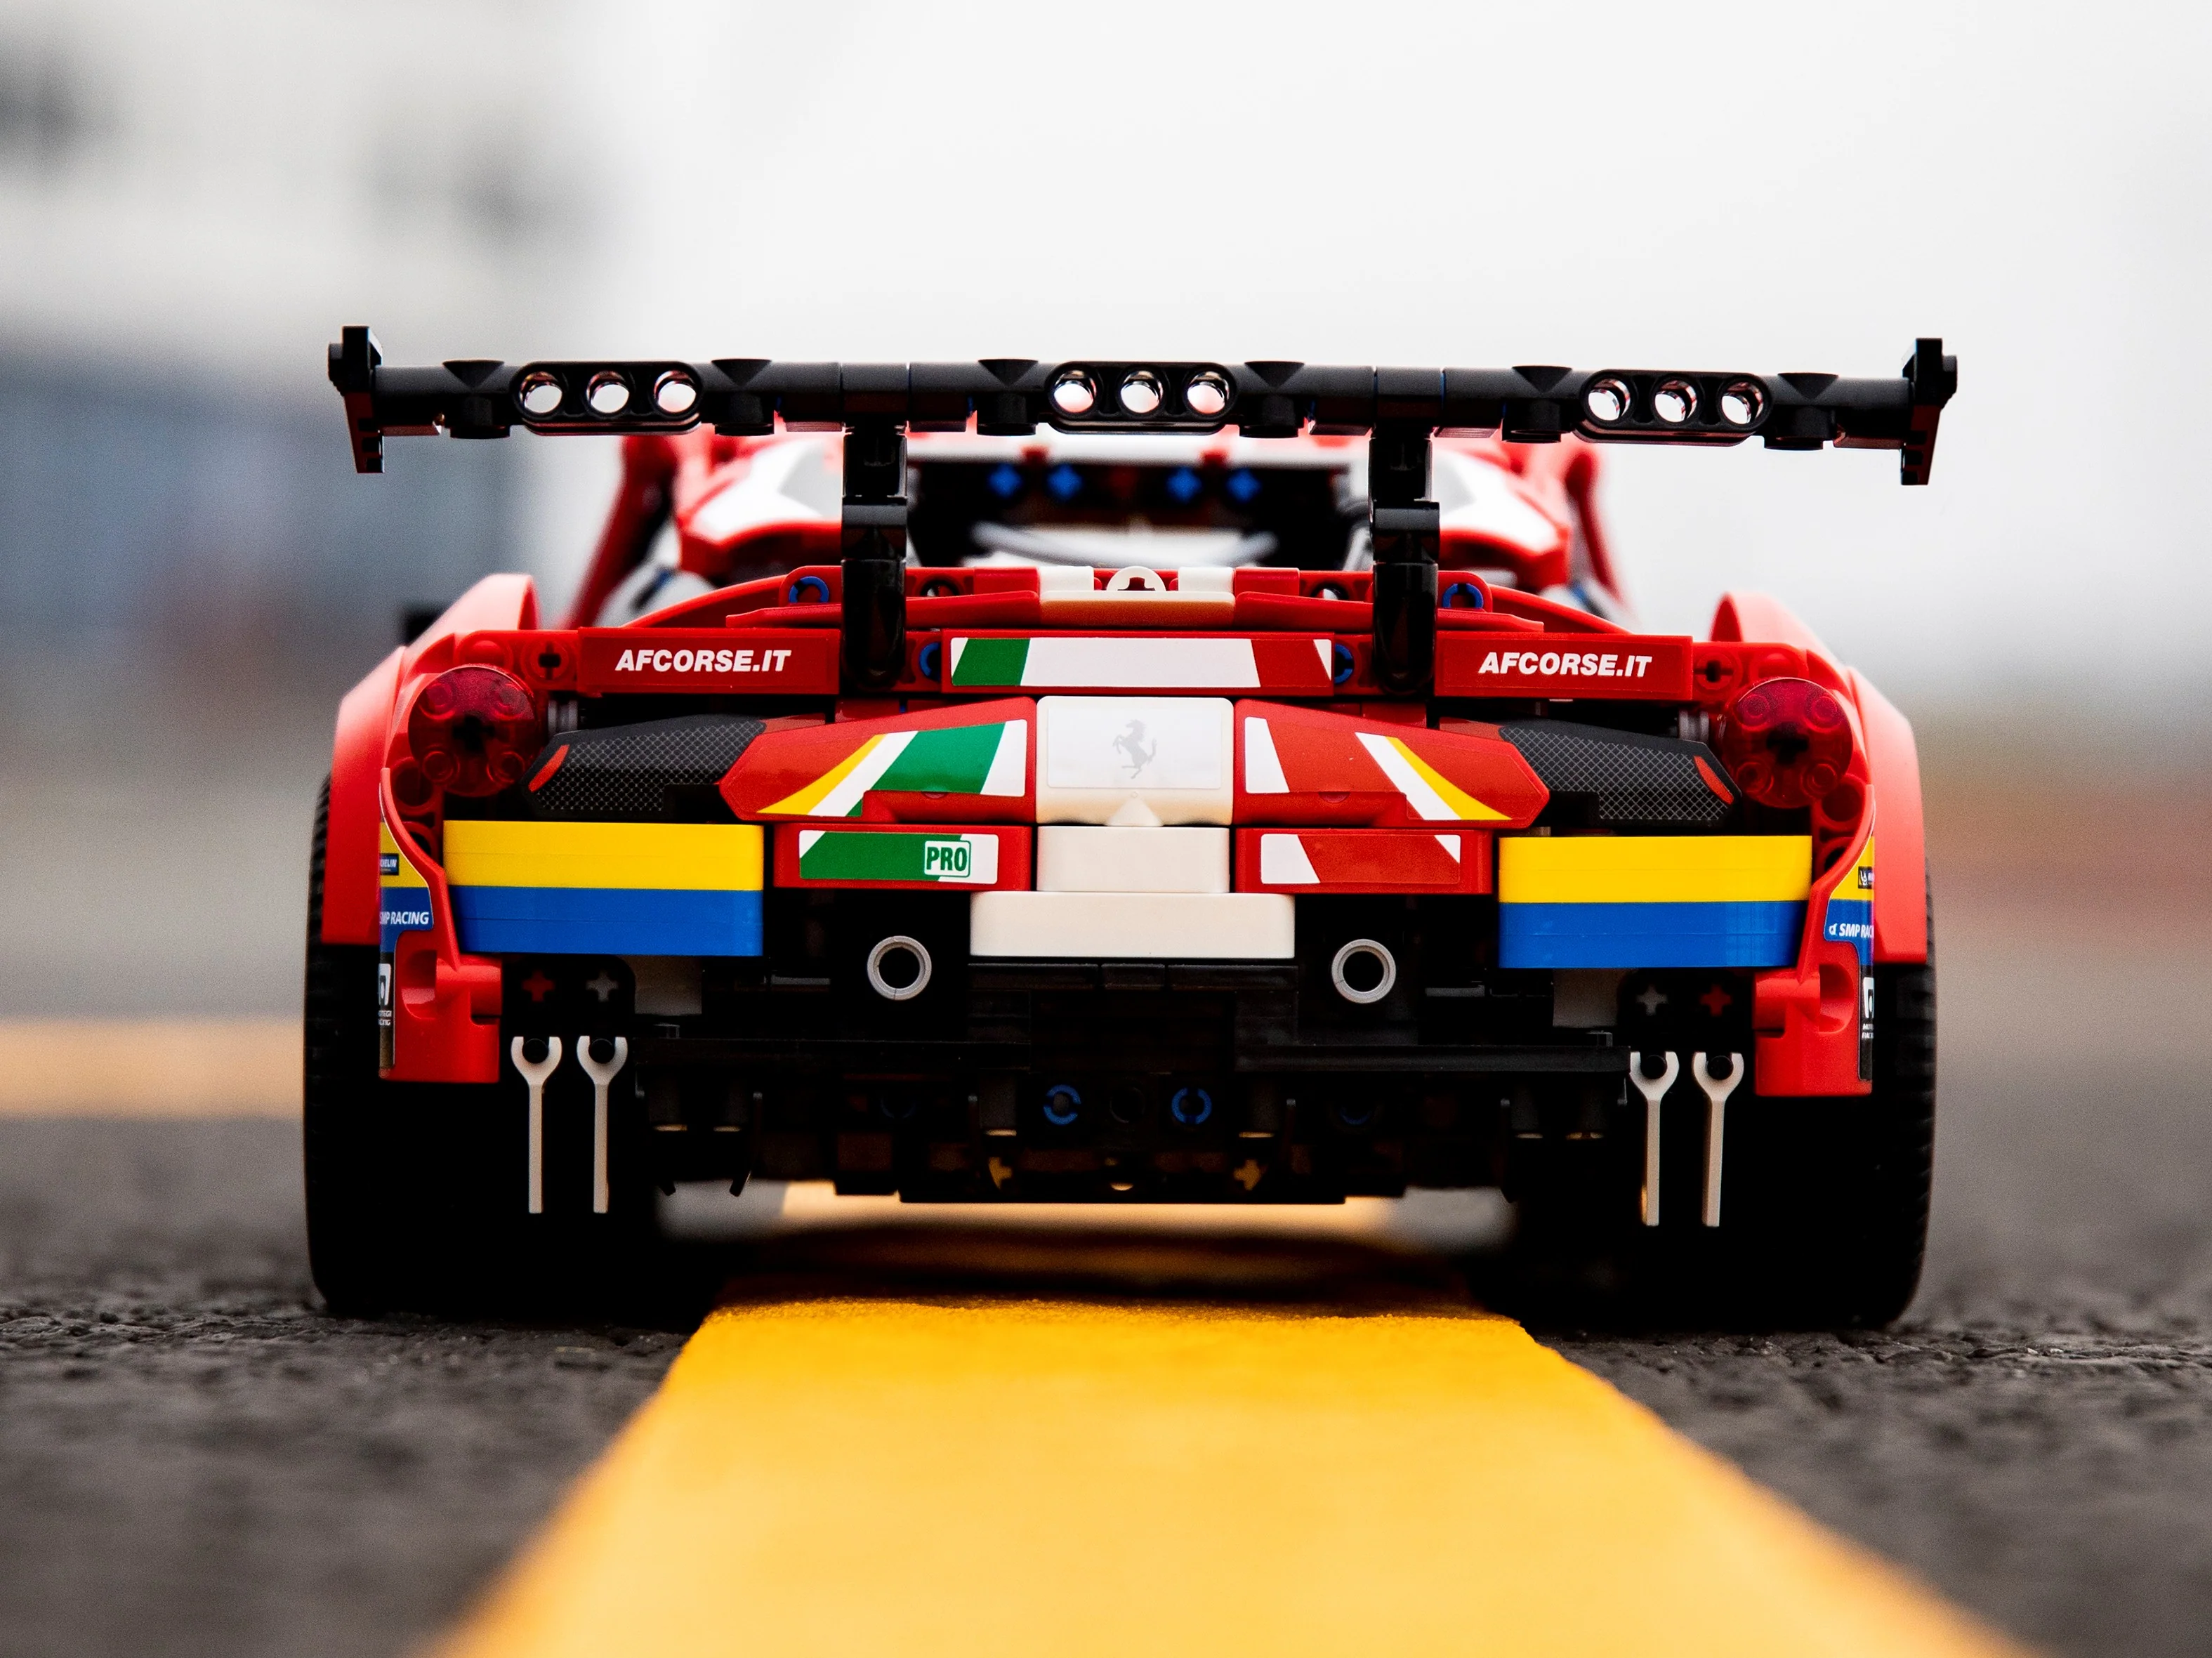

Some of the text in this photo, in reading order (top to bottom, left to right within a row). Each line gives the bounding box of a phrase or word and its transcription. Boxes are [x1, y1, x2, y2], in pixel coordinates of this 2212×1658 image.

[614, 649, 792, 673] AFCORSE.IT
[1477, 652, 1654, 678] AFCORSE.IT
[926, 846, 968, 871] PRO
[390, 911, 430, 925] RACING
[1838, 923, 1861, 937] SMP
